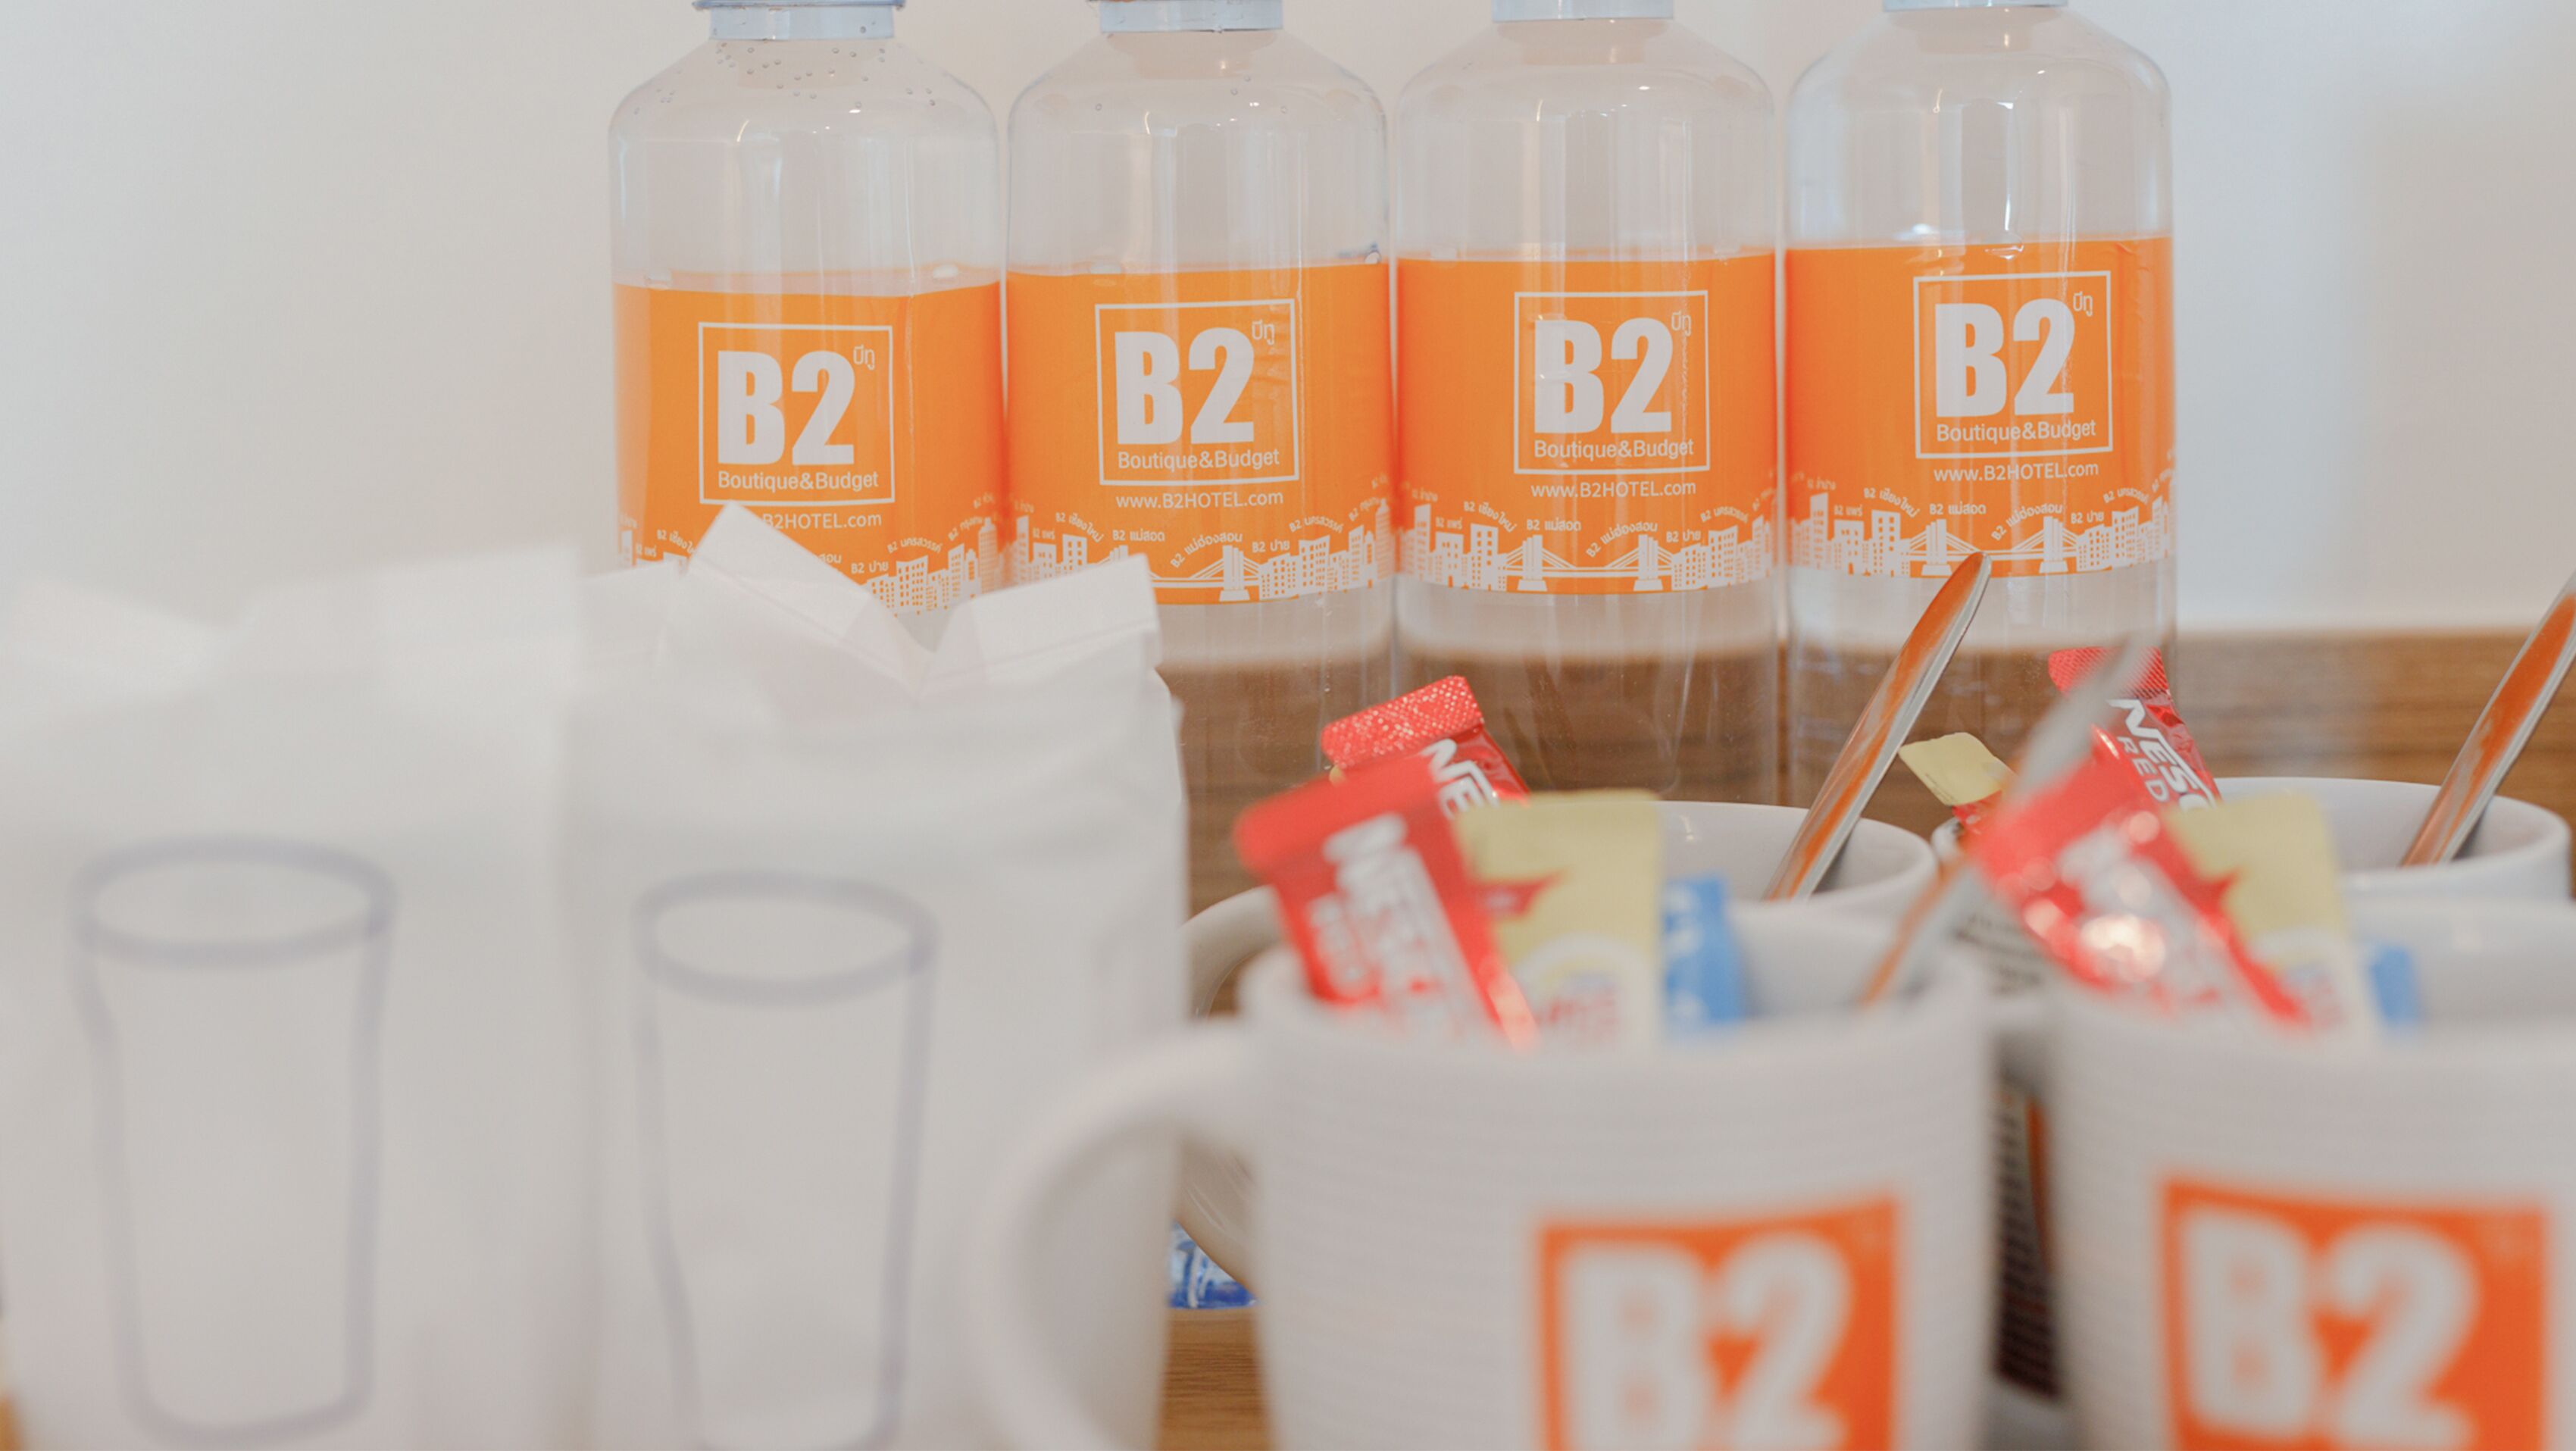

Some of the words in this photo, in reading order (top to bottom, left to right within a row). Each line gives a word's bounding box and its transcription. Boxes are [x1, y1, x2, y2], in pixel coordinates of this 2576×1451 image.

[1935, 298, 2075, 417] B2
[1534, 317, 1674, 433] B2
[1115, 327, 1255, 445] B2
[718, 349, 855, 464] B2
[1937, 420, 2096, 445] Boutique&Budget
[1534, 439, 1694, 461] Boutique&Budget
[1118, 448, 1280, 473] Boutique&Budget
[1933, 462, 2099, 483] www.B2HOTEL.com
[718, 471, 877, 493] Boutique&Budget
[1530, 481, 1696, 498] www.B2HOTEL.com
[1116, 491, 1284, 510] www.B2HOTEL.com
[1864, 488, 1876, 498] B2
[2103, 491, 2115, 503] B2
[1464, 502, 1475, 511] B2
[1930, 504, 1943, 514] B2
[1948, 501, 1986, 515] แม่สอด
[762, 513, 882, 530] B2HOTEL.com
[1055, 512, 1065, 522] B2
[1701, 510, 1711, 521] B2
[2071, 512, 2083, 524] B2
[1289, 520, 1302, 532] B2
[1527, 519, 1540, 530] B2
[1544, 517, 1582, 532] แม่สอด
[1112, 530, 1125, 541] B2
[1130, 528, 1165, 542] แม่สอด
[1666, 531, 1678, 543] B2
[1991, 525, 2006, 540] B2
[887, 542, 897, 553] B2
[1252, 542, 1265, 552] B2
[1586, 543, 1600, 557] B2
[851, 562, 864, 574] B2
[1171, 553, 1185, 568] B2
[2117, 736, 2170, 802] RED
[2185, 1212, 2484, 1441] B2
[1559, 1231, 1852, 1451] B2
